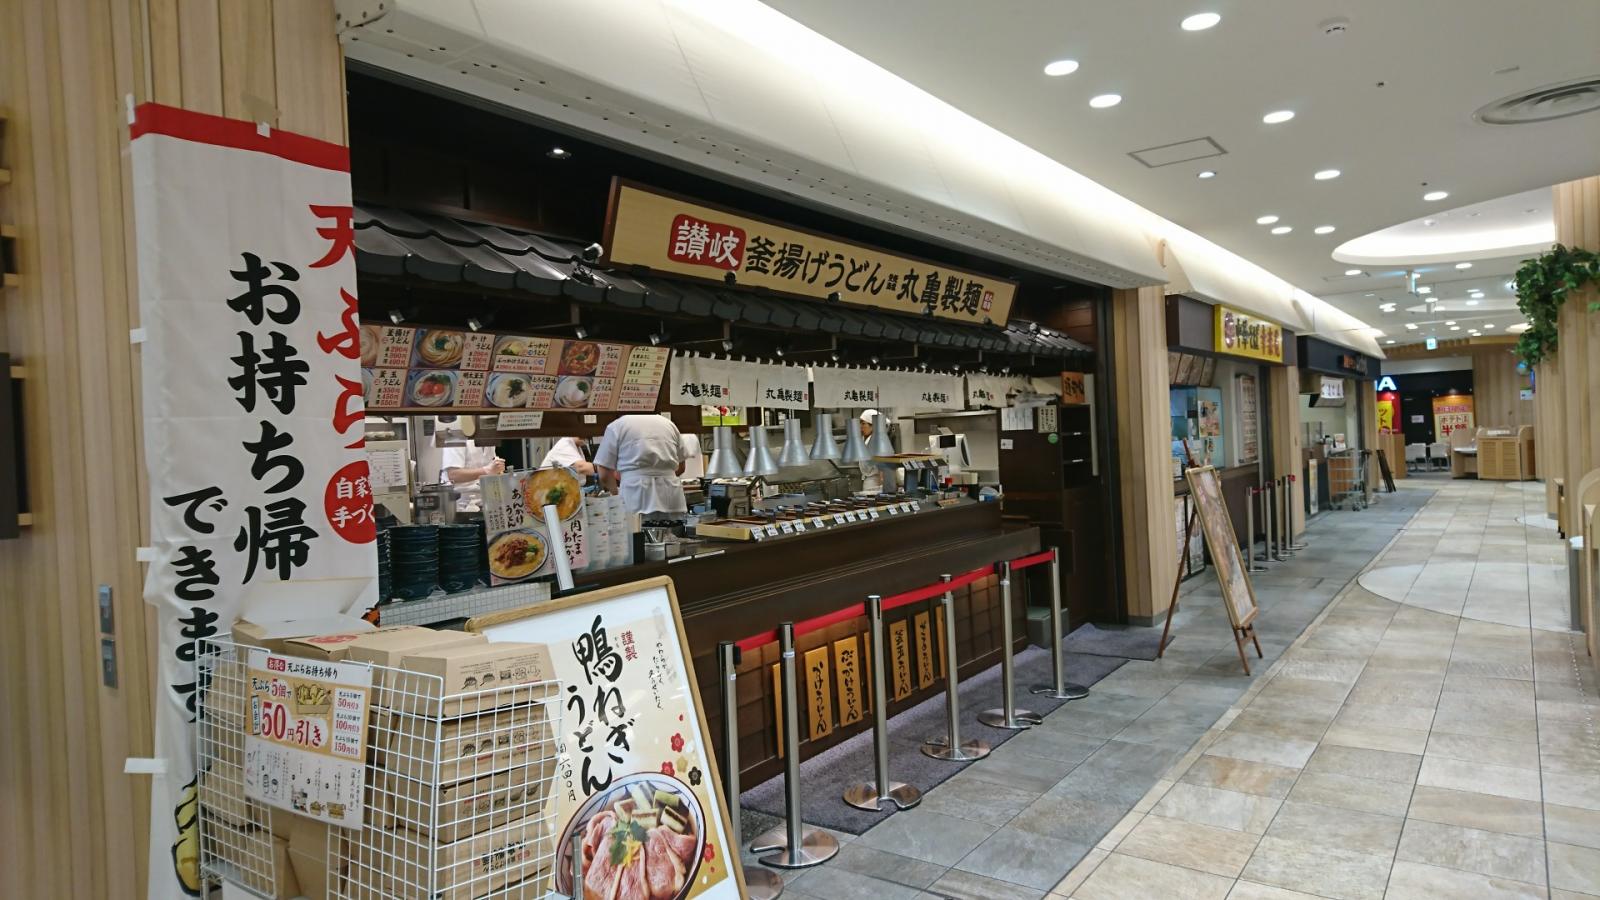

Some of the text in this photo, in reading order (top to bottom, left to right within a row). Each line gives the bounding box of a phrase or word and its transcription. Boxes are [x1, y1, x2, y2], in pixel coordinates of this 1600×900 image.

[674, 219, 985, 316] 讃岐 釜揚げうどん 丸亀製麺
[765, 388, 803, 402] 丸亀製麺
[844, 389, 874, 402] 丸亀製麺
[1374, 376, 1397, 391] A
[226, 251, 320, 585] お持ち帰
[335, 476, 373, 499] 自家
[162, 485, 228, 723] できます
[287, 662, 338, 679] 天ぷらお持ち帰り
[571, 614, 635, 764] 鴨ねぎ
[262, 701, 322, 747] 50円引き
[567, 685, 613, 797] うどん
